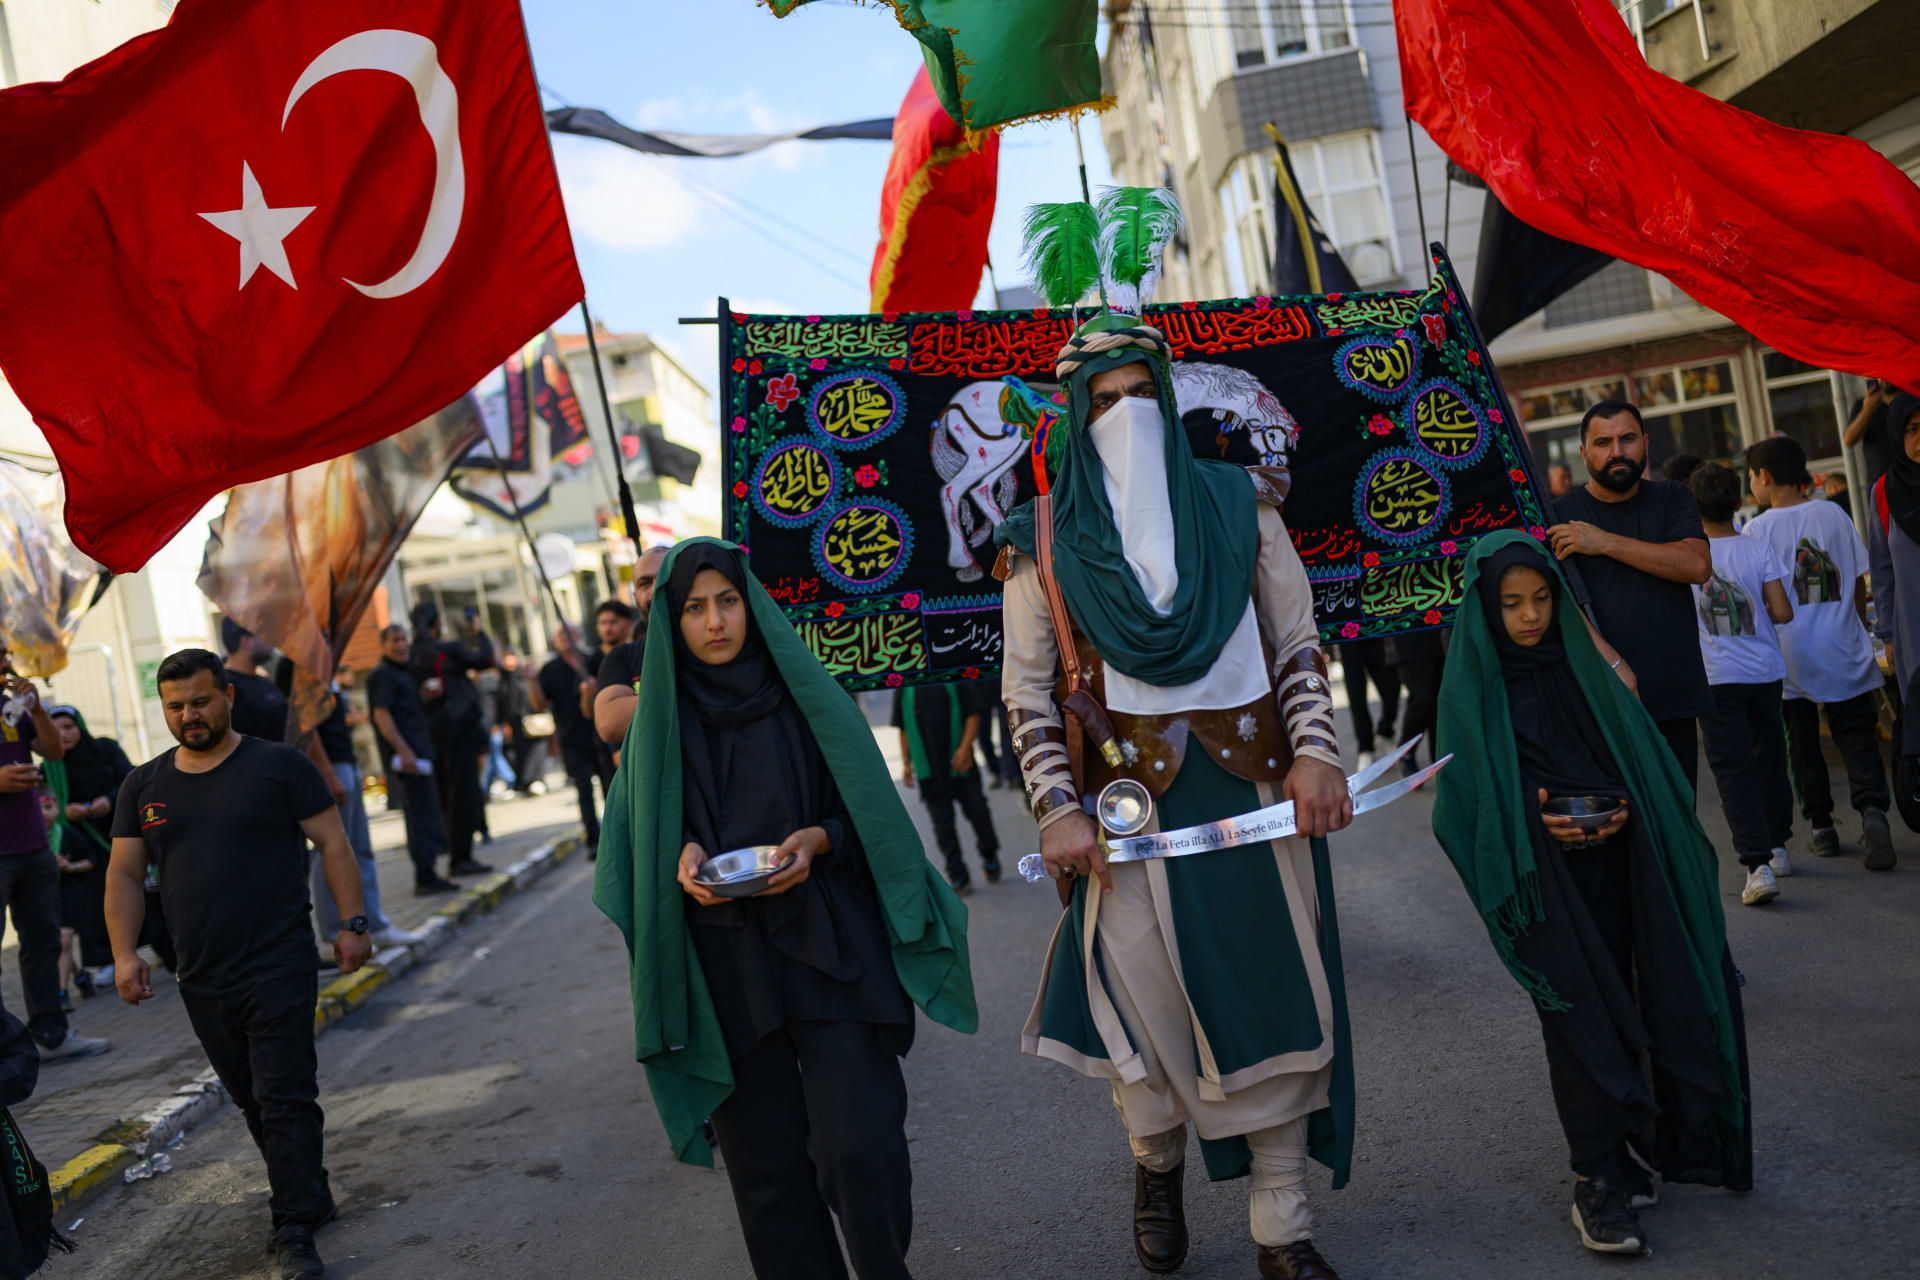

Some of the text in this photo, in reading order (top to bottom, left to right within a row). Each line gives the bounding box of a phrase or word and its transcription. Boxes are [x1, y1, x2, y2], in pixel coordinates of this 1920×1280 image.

[825, 389, 892, 433] محمد
[1155, 840, 1168, 851] La
[1169, 837, 1190, 850] Feta
[1191, 835, 1208, 848] illa
[1228, 829, 1241, 841] La
[1240, 823, 1267, 841] Seyfe
[1267, 819, 1283, 833] illa
